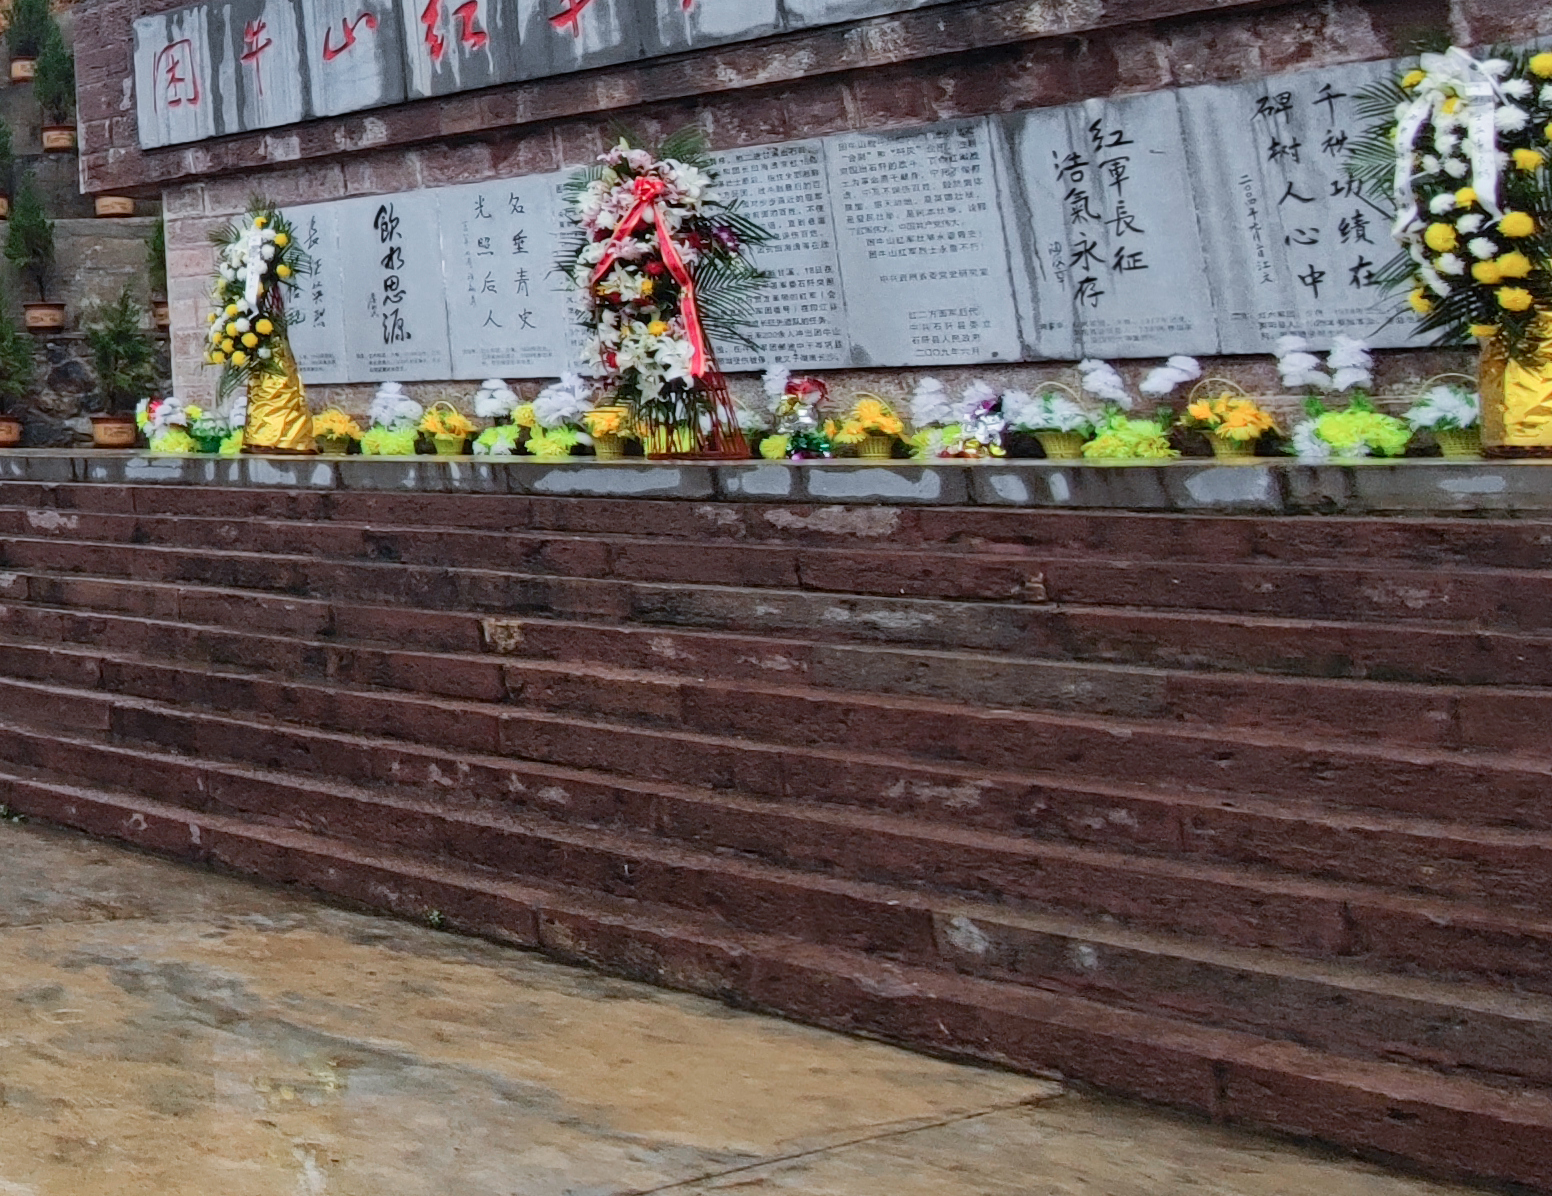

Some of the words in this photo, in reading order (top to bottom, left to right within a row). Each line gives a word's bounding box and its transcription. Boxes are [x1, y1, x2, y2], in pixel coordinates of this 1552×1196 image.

[473, 194, 503, 328] 光照后人
[507, 192, 537, 330] 名垂青史
